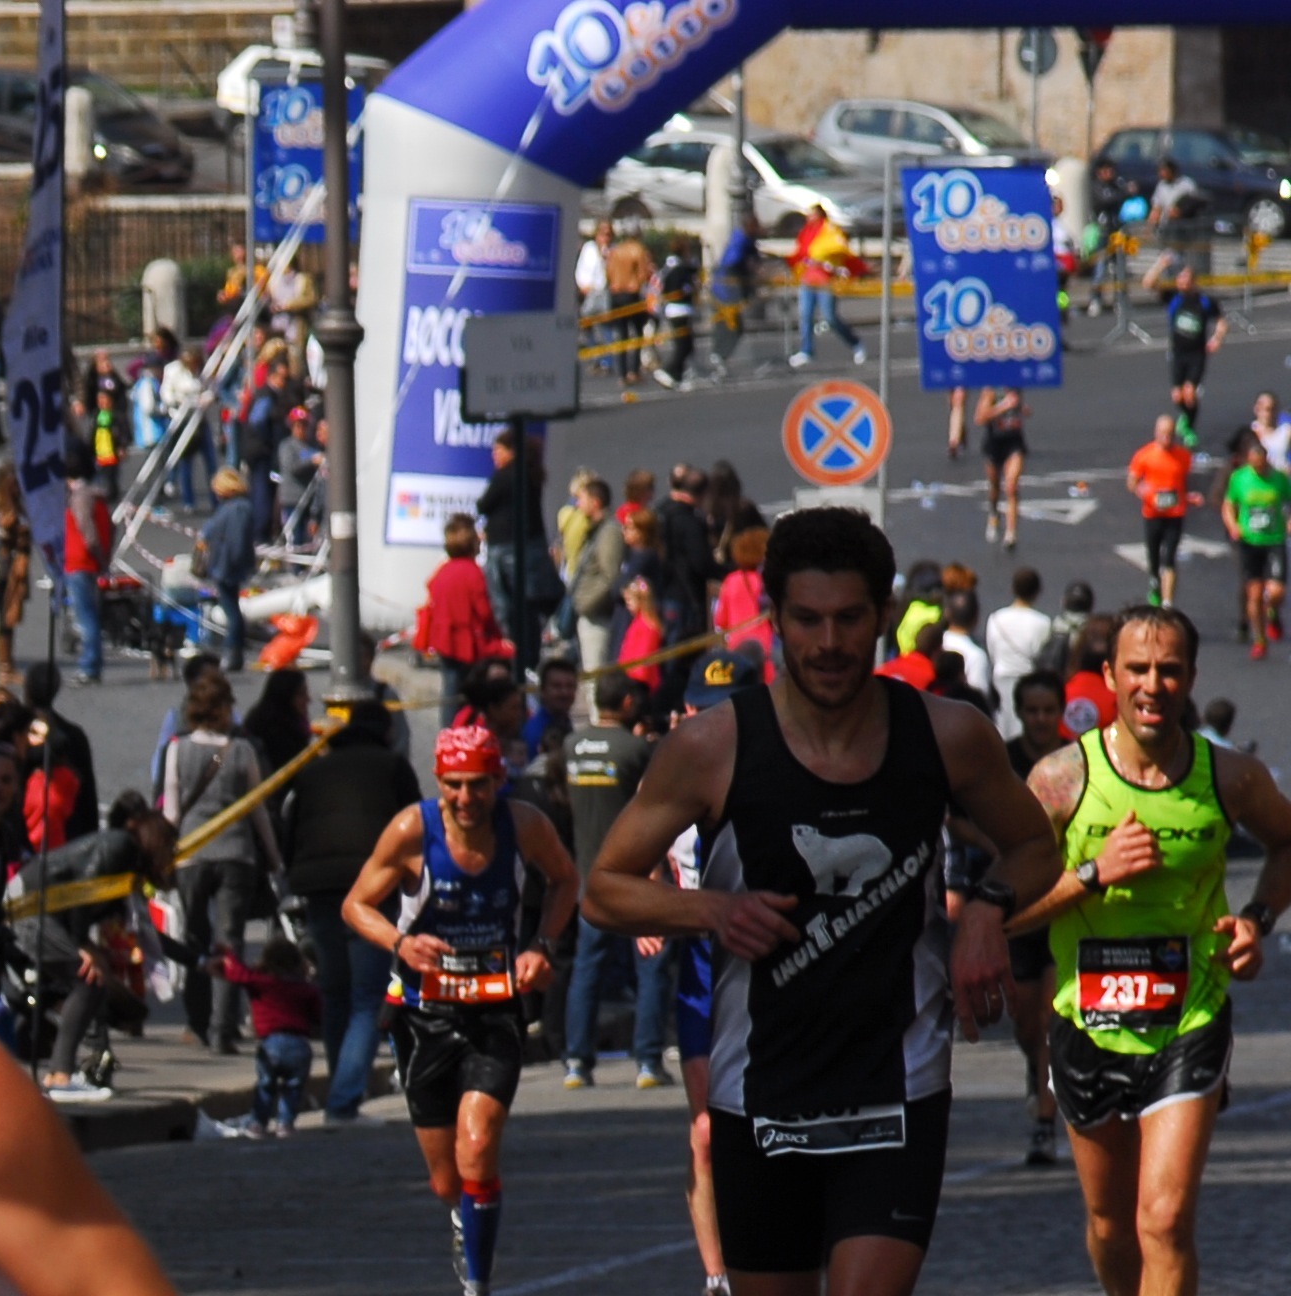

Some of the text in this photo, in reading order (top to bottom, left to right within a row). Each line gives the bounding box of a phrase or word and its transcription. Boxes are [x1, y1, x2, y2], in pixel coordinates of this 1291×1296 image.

[913, 170, 983, 231] 10
[924, 278, 992, 340] 10
[1101, 975, 1149, 1006] 237
